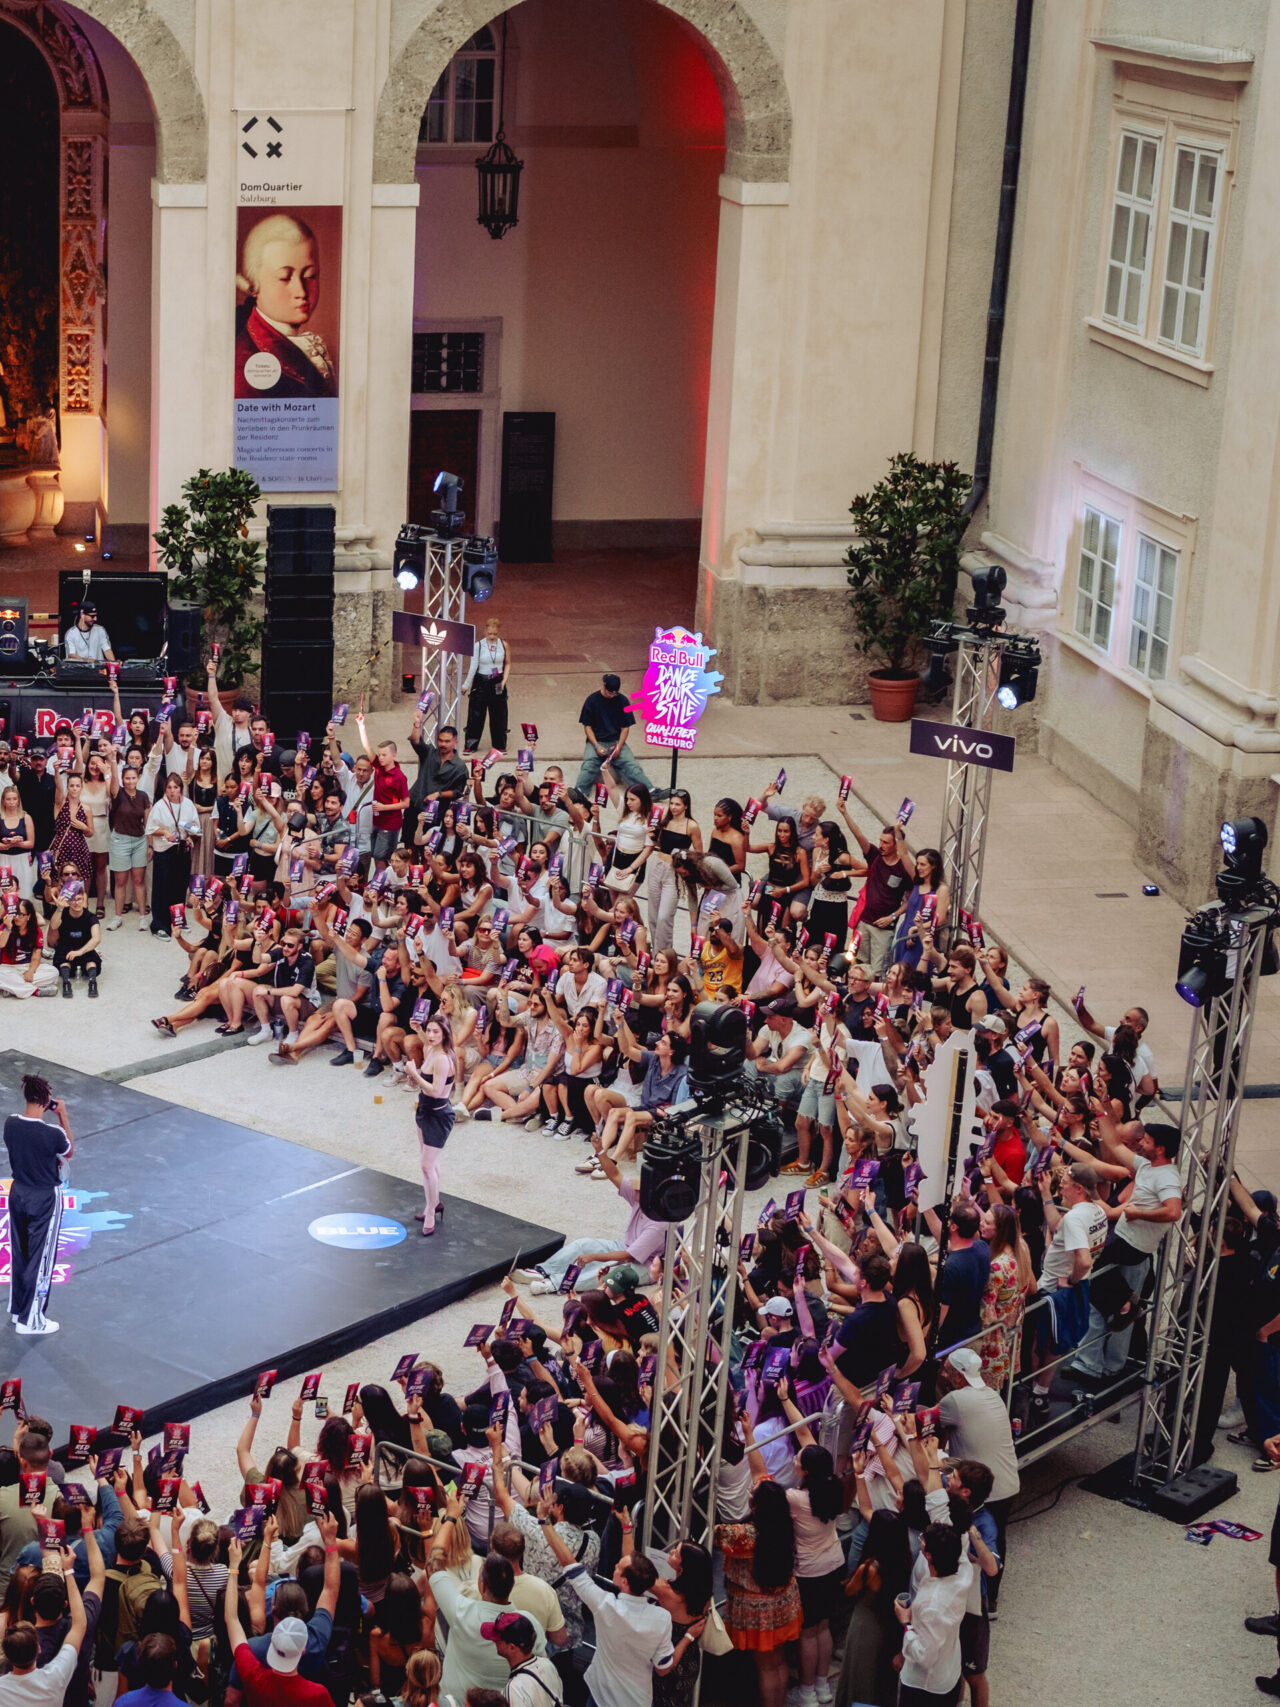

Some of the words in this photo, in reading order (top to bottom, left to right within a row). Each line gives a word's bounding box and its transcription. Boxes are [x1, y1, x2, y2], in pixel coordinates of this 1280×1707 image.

[240, 183, 302, 191] DomQuartier
[240, 195, 276, 204] Salzburg
[652, 648, 676, 663] Red
[680, 652, 703, 667] Bull
[655, 665, 699, 686] DANCE
[659, 681, 700, 704] YOUR
[654, 696, 698, 725] STYLE
[646, 722, 696, 742] QUALIFIER
[647, 735, 693, 749] SALZBURG
[934, 734, 993, 758] vivo
[709, 970, 723, 982] 23
[316, 1227, 400, 1235] BLUE
[351, 1452, 364, 1460] RED
